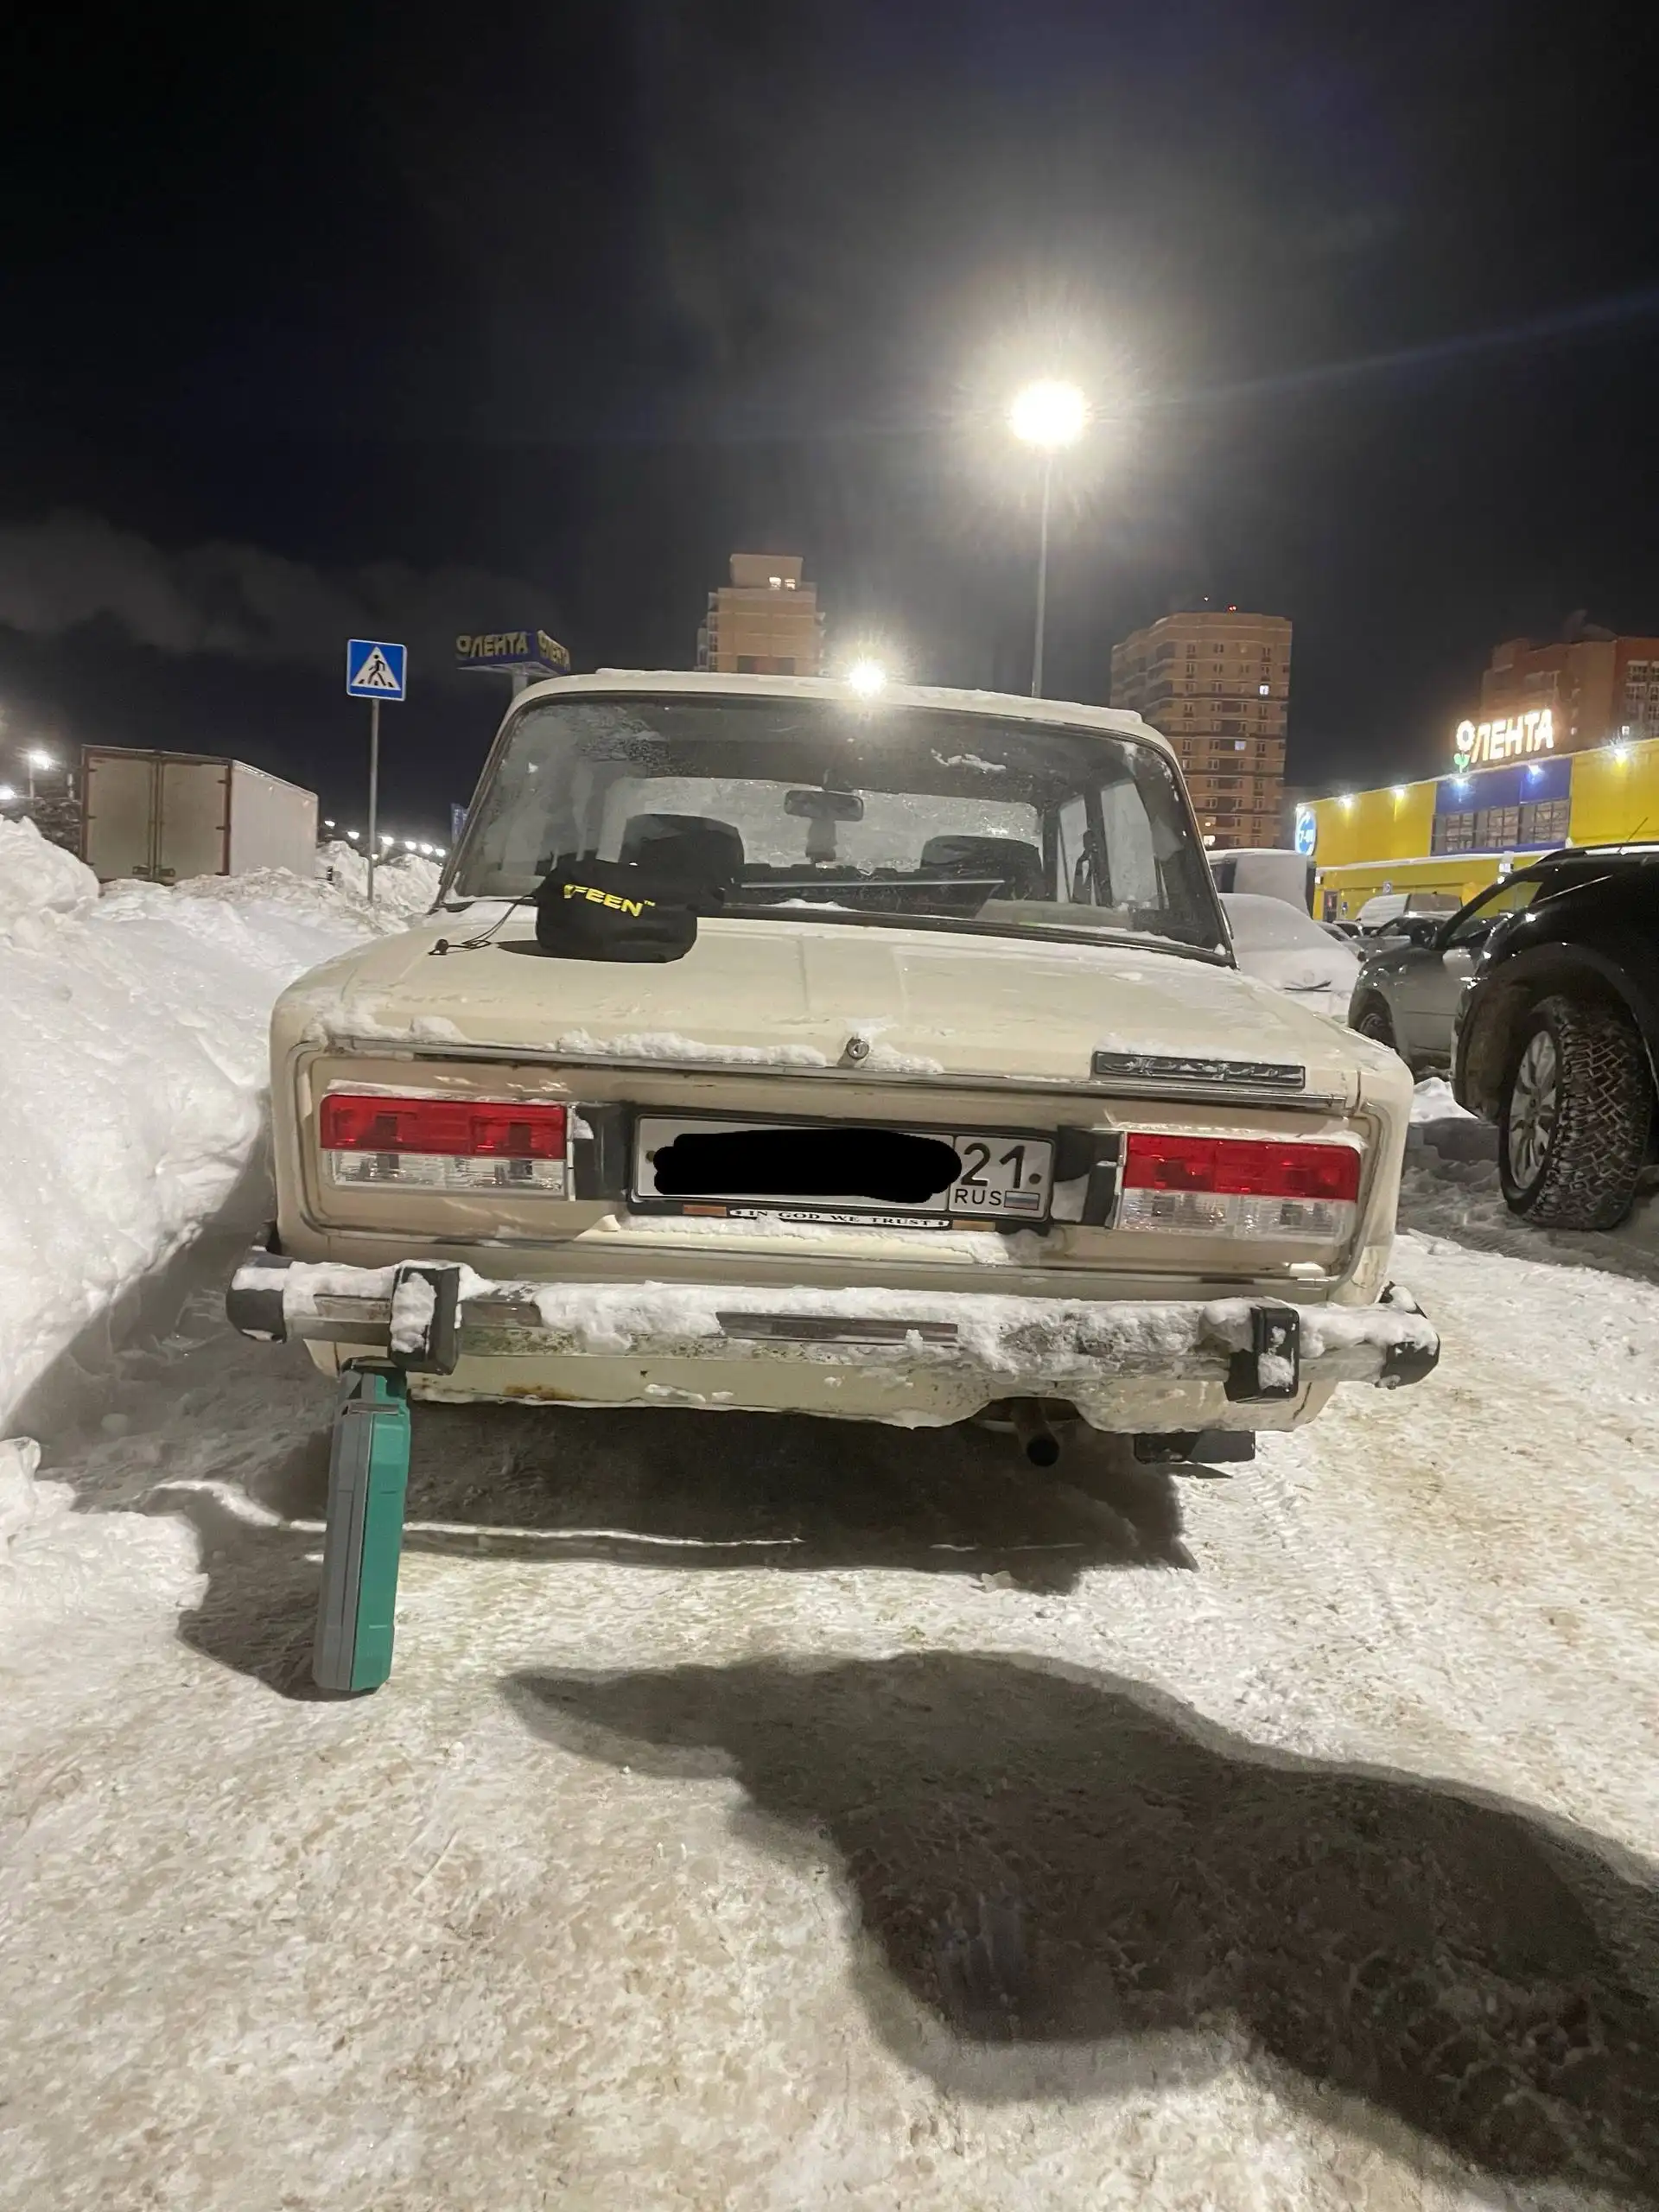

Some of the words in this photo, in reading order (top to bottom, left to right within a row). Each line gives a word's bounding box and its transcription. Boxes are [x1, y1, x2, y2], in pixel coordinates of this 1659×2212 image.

[469, 632, 529, 658] ЛЕНТА
[1470, 709, 1554, 764] ЛЕНТА
[960, 1142, 1026, 1189] 21
[954, 1188, 1002, 1206] RUS
[869, 1217, 931, 1226] TRUST
